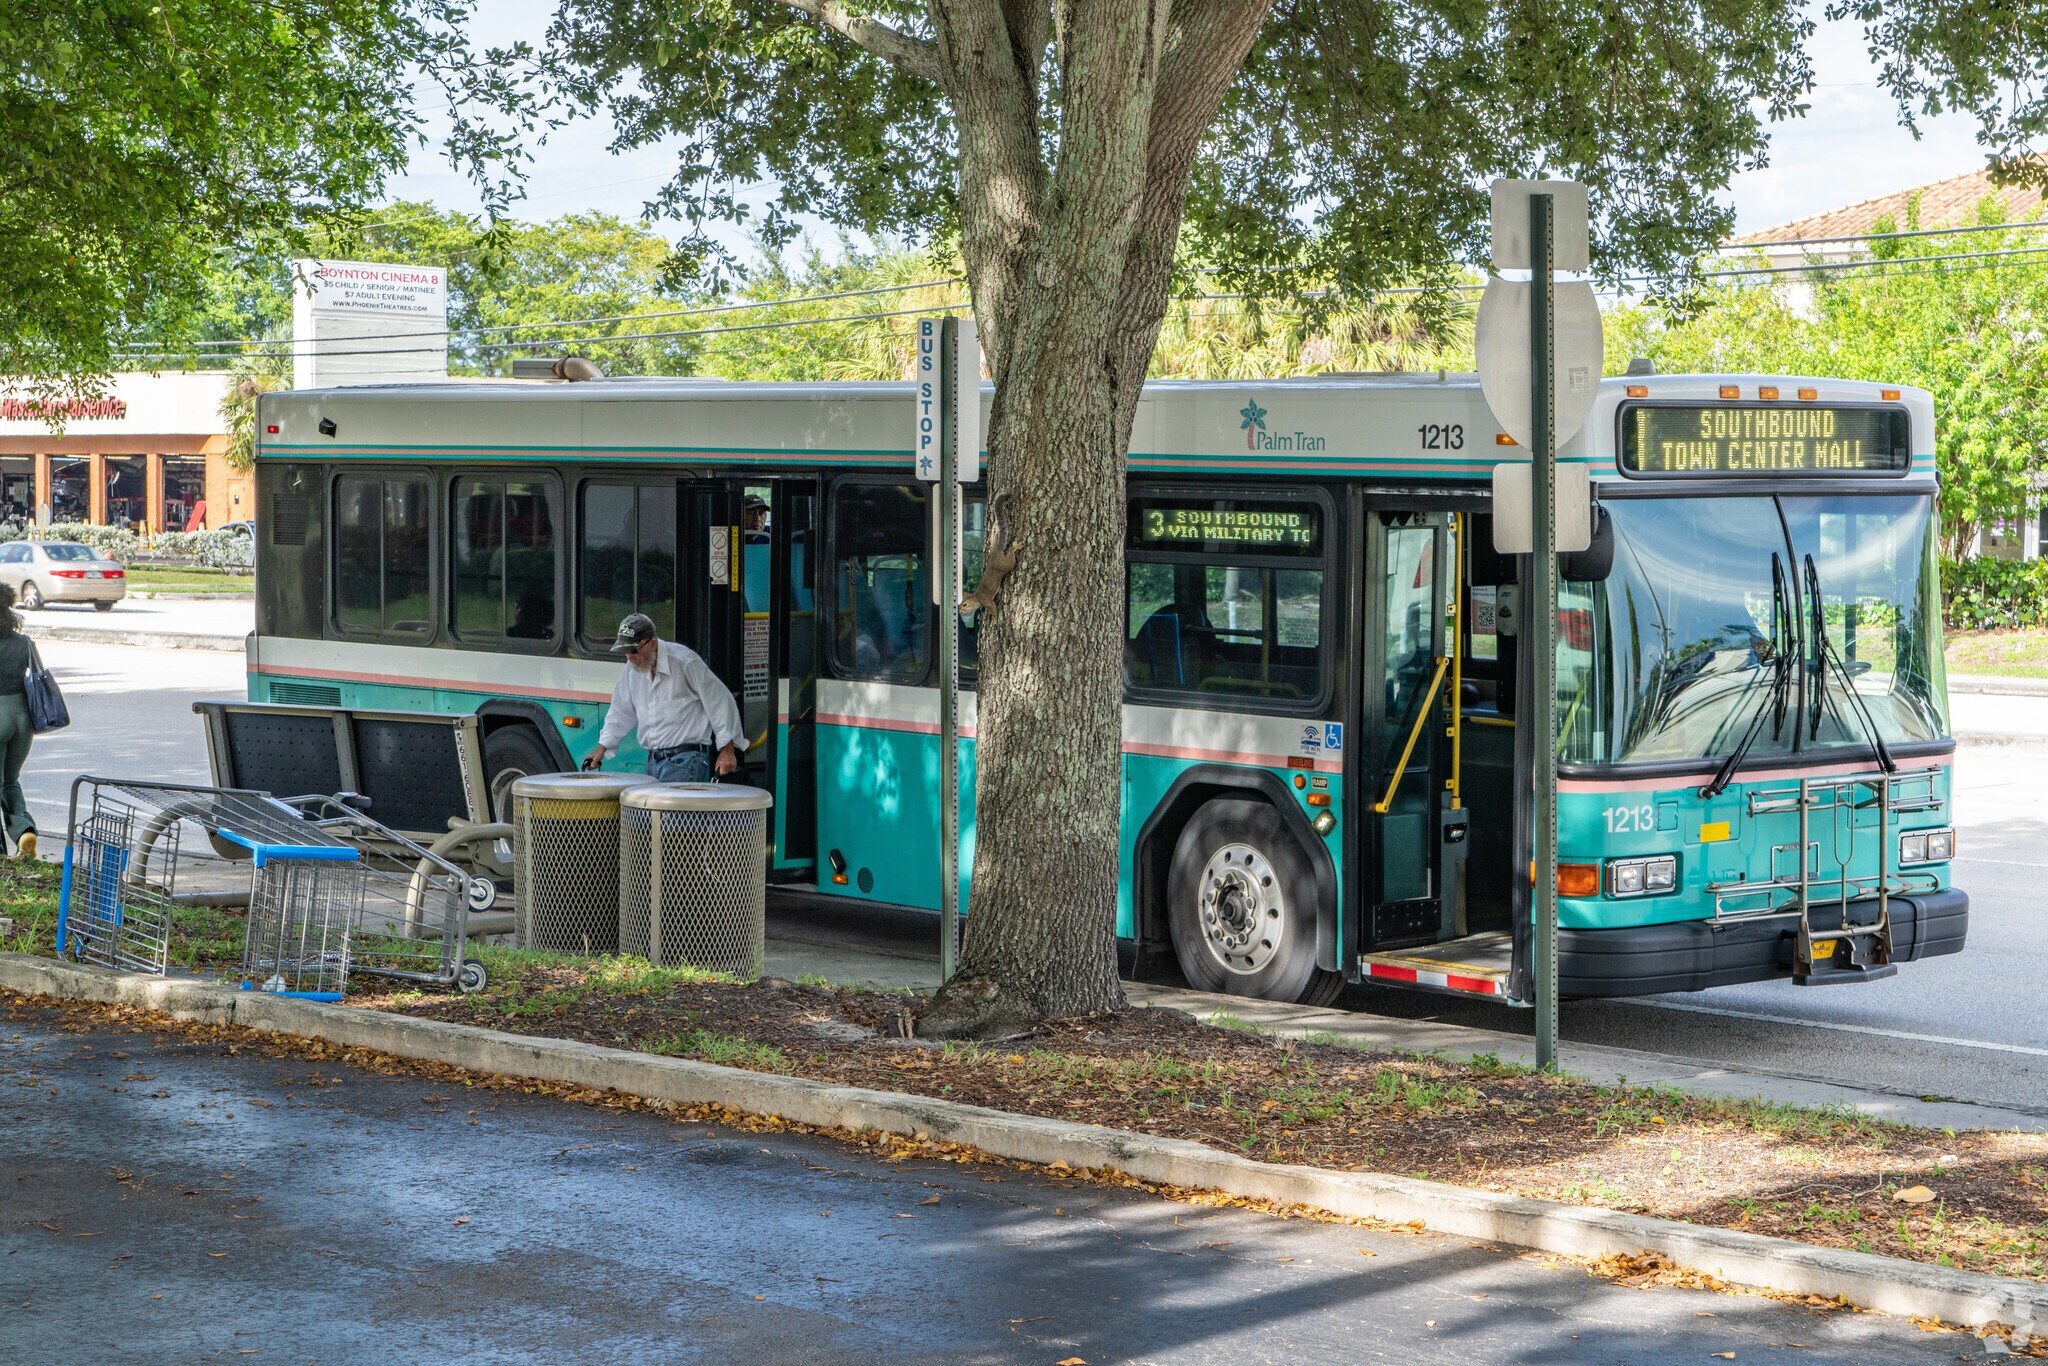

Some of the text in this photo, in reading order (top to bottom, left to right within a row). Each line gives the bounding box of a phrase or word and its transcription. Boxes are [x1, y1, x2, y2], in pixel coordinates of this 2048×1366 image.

[320, 267, 439, 285] BOYNTON CINEMA 8
[323, 280, 334, 288] $5
[335, 281, 359, 289] CHILD
[366, 284, 395, 292] SENIOR
[402, 286, 436, 295] MATINEE
[382, 293, 416, 302] EVENING
[920, 320, 933, 450] BUS STOP
[1700, 410, 1835, 438] SOUTHBOUND
[1257, 431, 1326, 451] Palm Tran
[1418, 424, 1464, 450] 1213
[1662, 440, 1865, 470] TOWN CENTER MALL
[1150, 510, 1164, 537] 3
[1176, 511, 1300, 527] SOUTHBOUND
[1168, 525, 1199, 538] VIA
[1204, 526, 1285, 542] MILITARY
[1602, 804, 1654, 833] 1213
